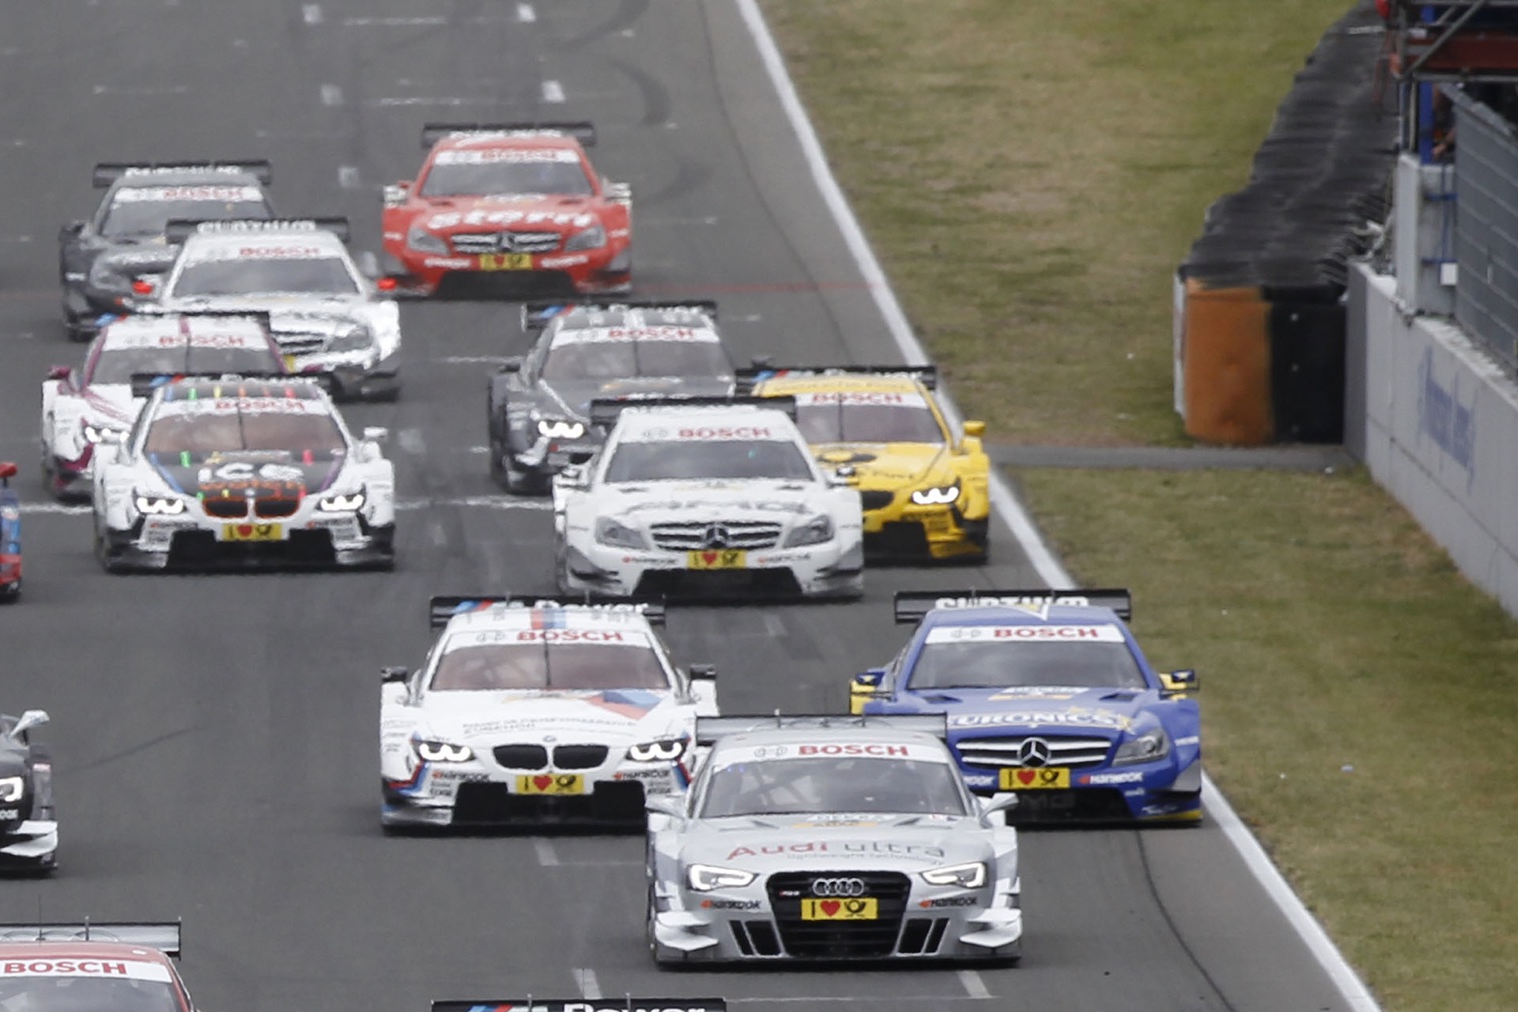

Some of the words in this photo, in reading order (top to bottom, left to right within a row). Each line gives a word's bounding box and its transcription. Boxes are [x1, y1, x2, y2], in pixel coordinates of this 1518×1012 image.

[516, 630, 624, 641] BOSCH
[993, 627, 1099, 639] BOSCH
[798, 745, 909, 757] BOSCH
[726, 842, 828, 861] Audi
[844, 842, 945, 859] ultra
[3, 961, 128, 976] BOSCH
